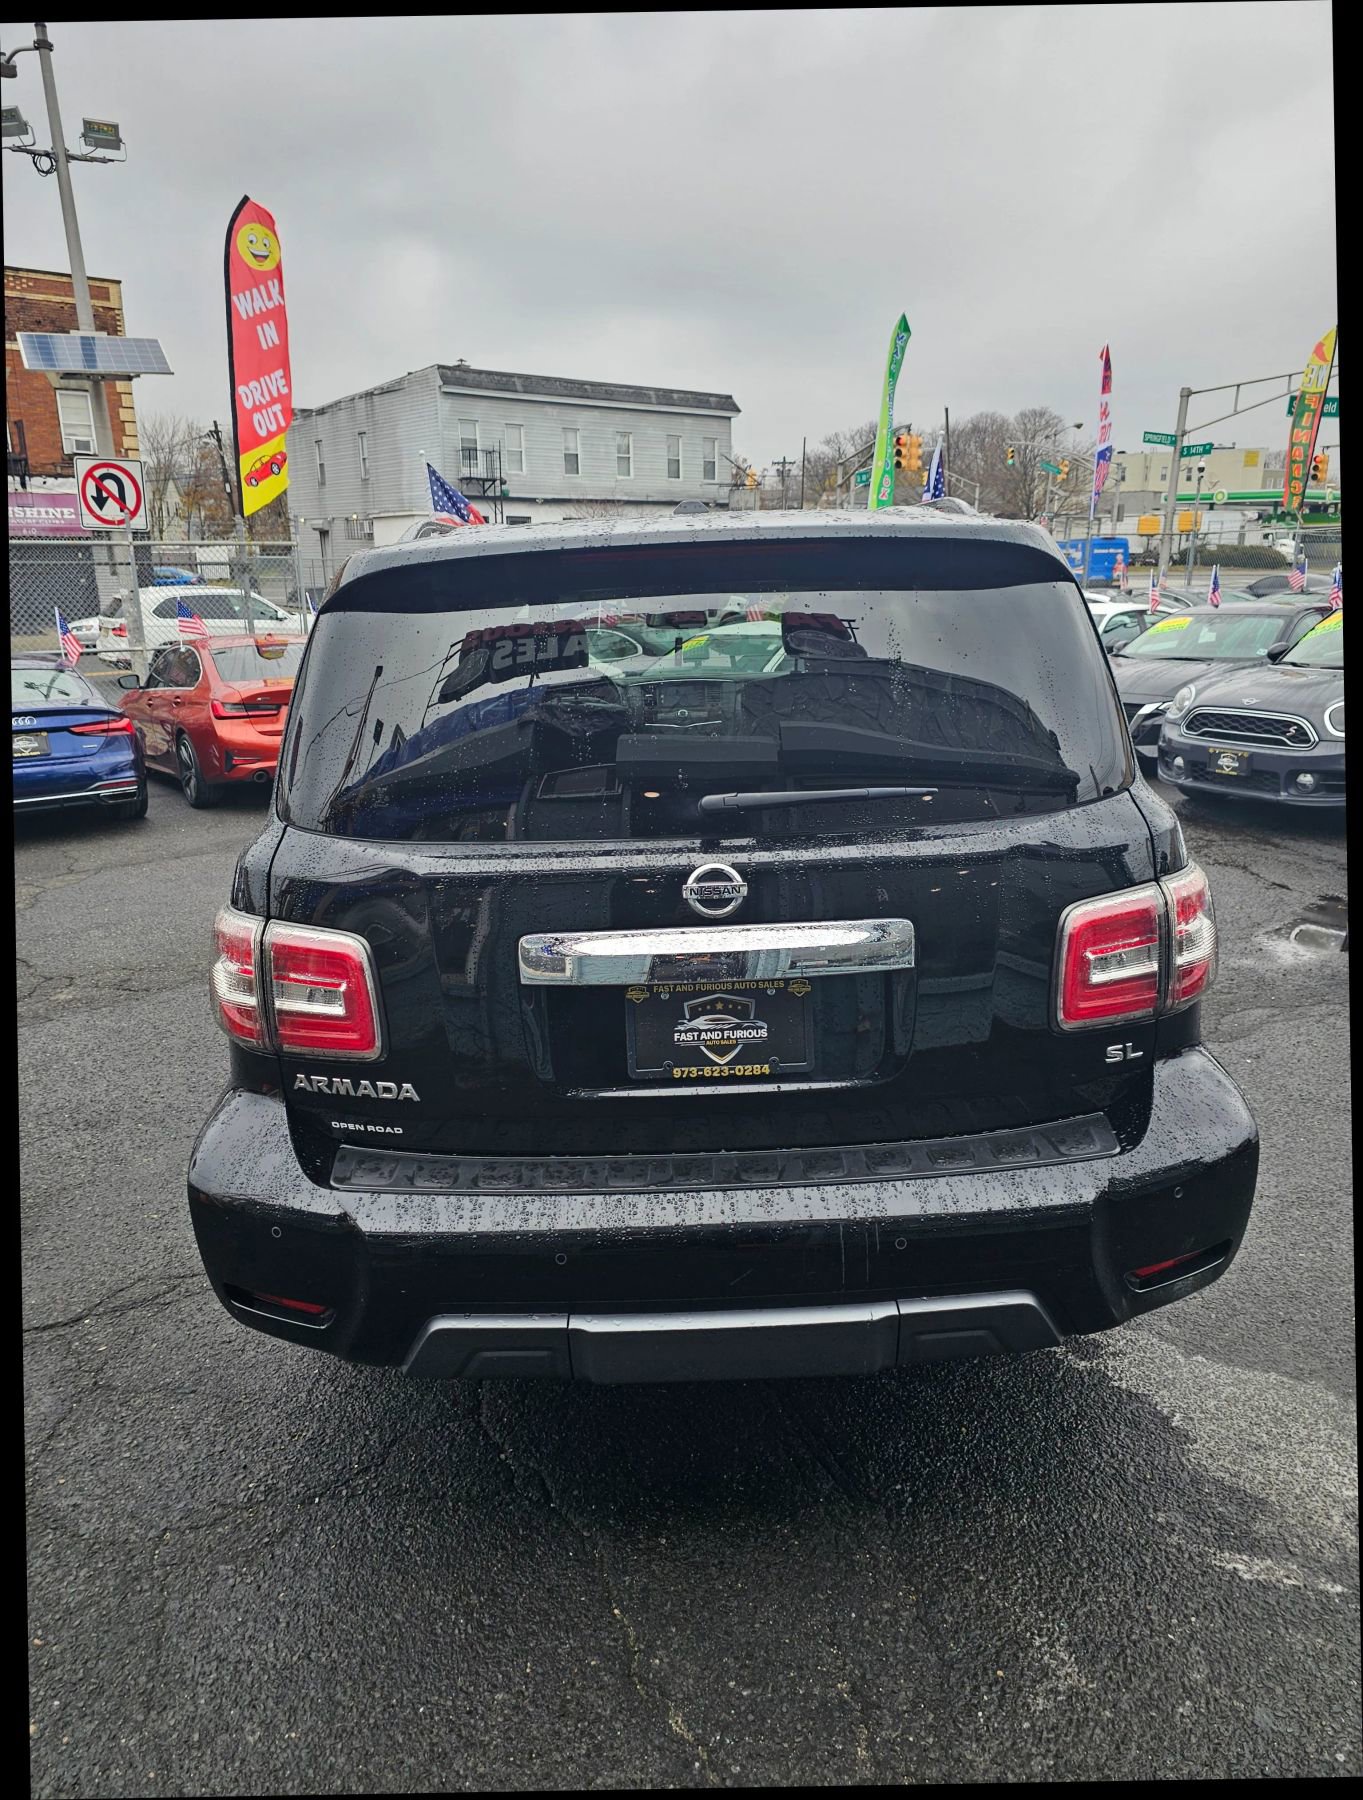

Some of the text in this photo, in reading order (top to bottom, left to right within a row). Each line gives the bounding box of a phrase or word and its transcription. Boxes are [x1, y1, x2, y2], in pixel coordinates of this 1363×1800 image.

[233, 279, 284, 320] WALK
[256, 320, 280, 350] IN
[238, 369, 289, 410] DRIVE
[253, 403, 286, 437] OUT
[1182, 447, 1188, 456] S
[1190, 446, 1204, 454] 14TH
[689, 886, 741, 896] NISSAN
[653, 980, 785, 993] FAST AND FURIOUS AUTO SALES
[673, 1028, 768, 1042] FAST AND FURIOUS
[1105, 1042, 1144, 1063] SL
[672, 1064, 770, 1078] 973-623-0284
[293, 1073, 421, 1102] ARMADA
[331, 1121, 403, 1134] OPEN ROAD
